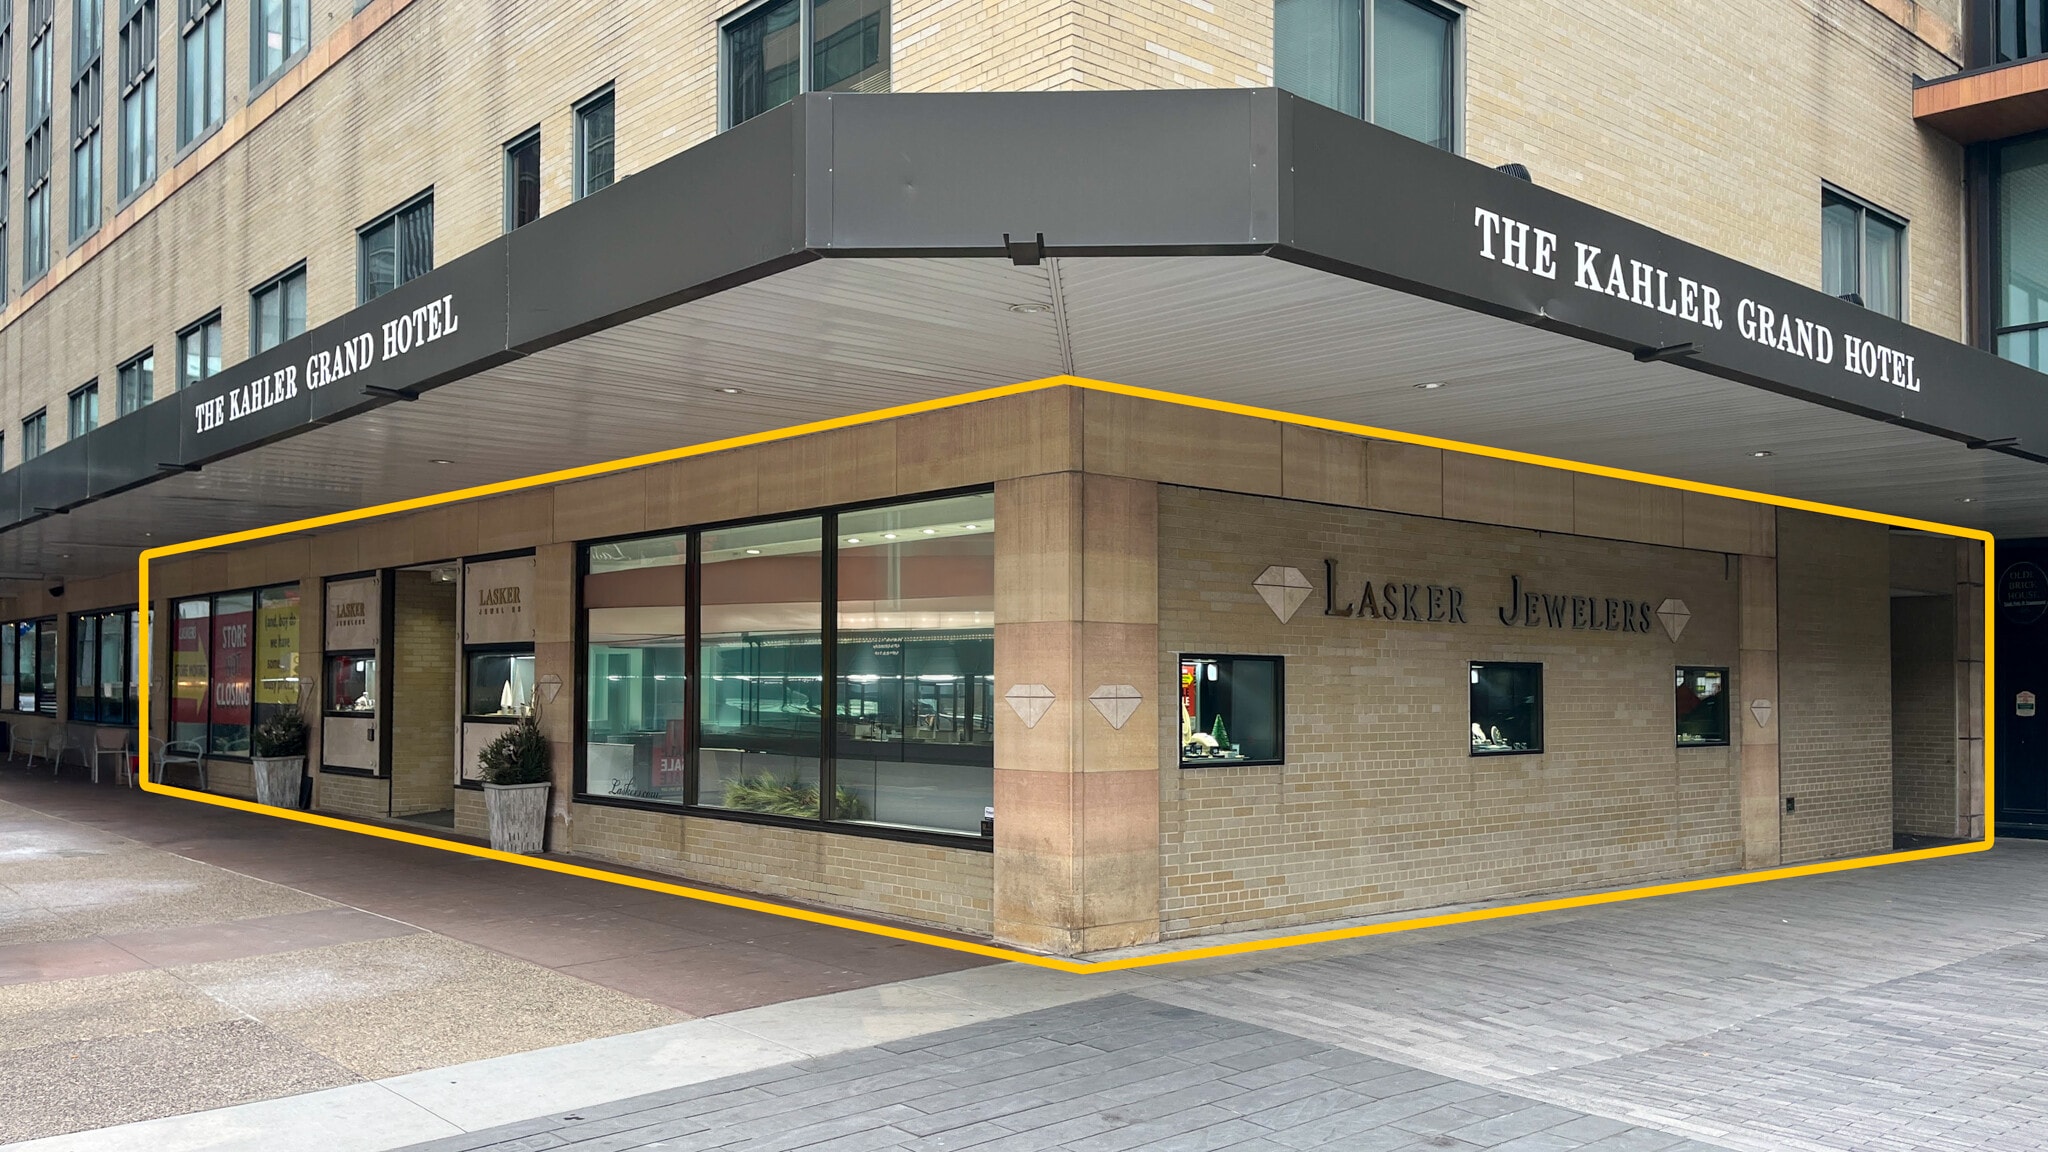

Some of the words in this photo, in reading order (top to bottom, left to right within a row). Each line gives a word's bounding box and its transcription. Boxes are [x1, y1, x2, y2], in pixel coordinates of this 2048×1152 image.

[1474, 206, 1557, 280] THE
[1574, 241, 1723, 330] KAHLER
[1737, 298, 1833, 364] GRAND
[1844, 333, 1921, 393] HOTEL
[195, 395, 224, 434] THE
[229, 365, 297, 421] KAHLER
[306, 332, 374, 390] GRAND
[382, 294, 458, 361] HOTEL
[479, 586, 520, 606] LASKER
[1324, 558, 1468, 624] LASKER
[1499, 574, 1653, 634] JEWELERS
[336, 602, 365, 618] LASKER
[222, 624, 247, 648] STORE
[216, 681, 250, 706] CLOSING
